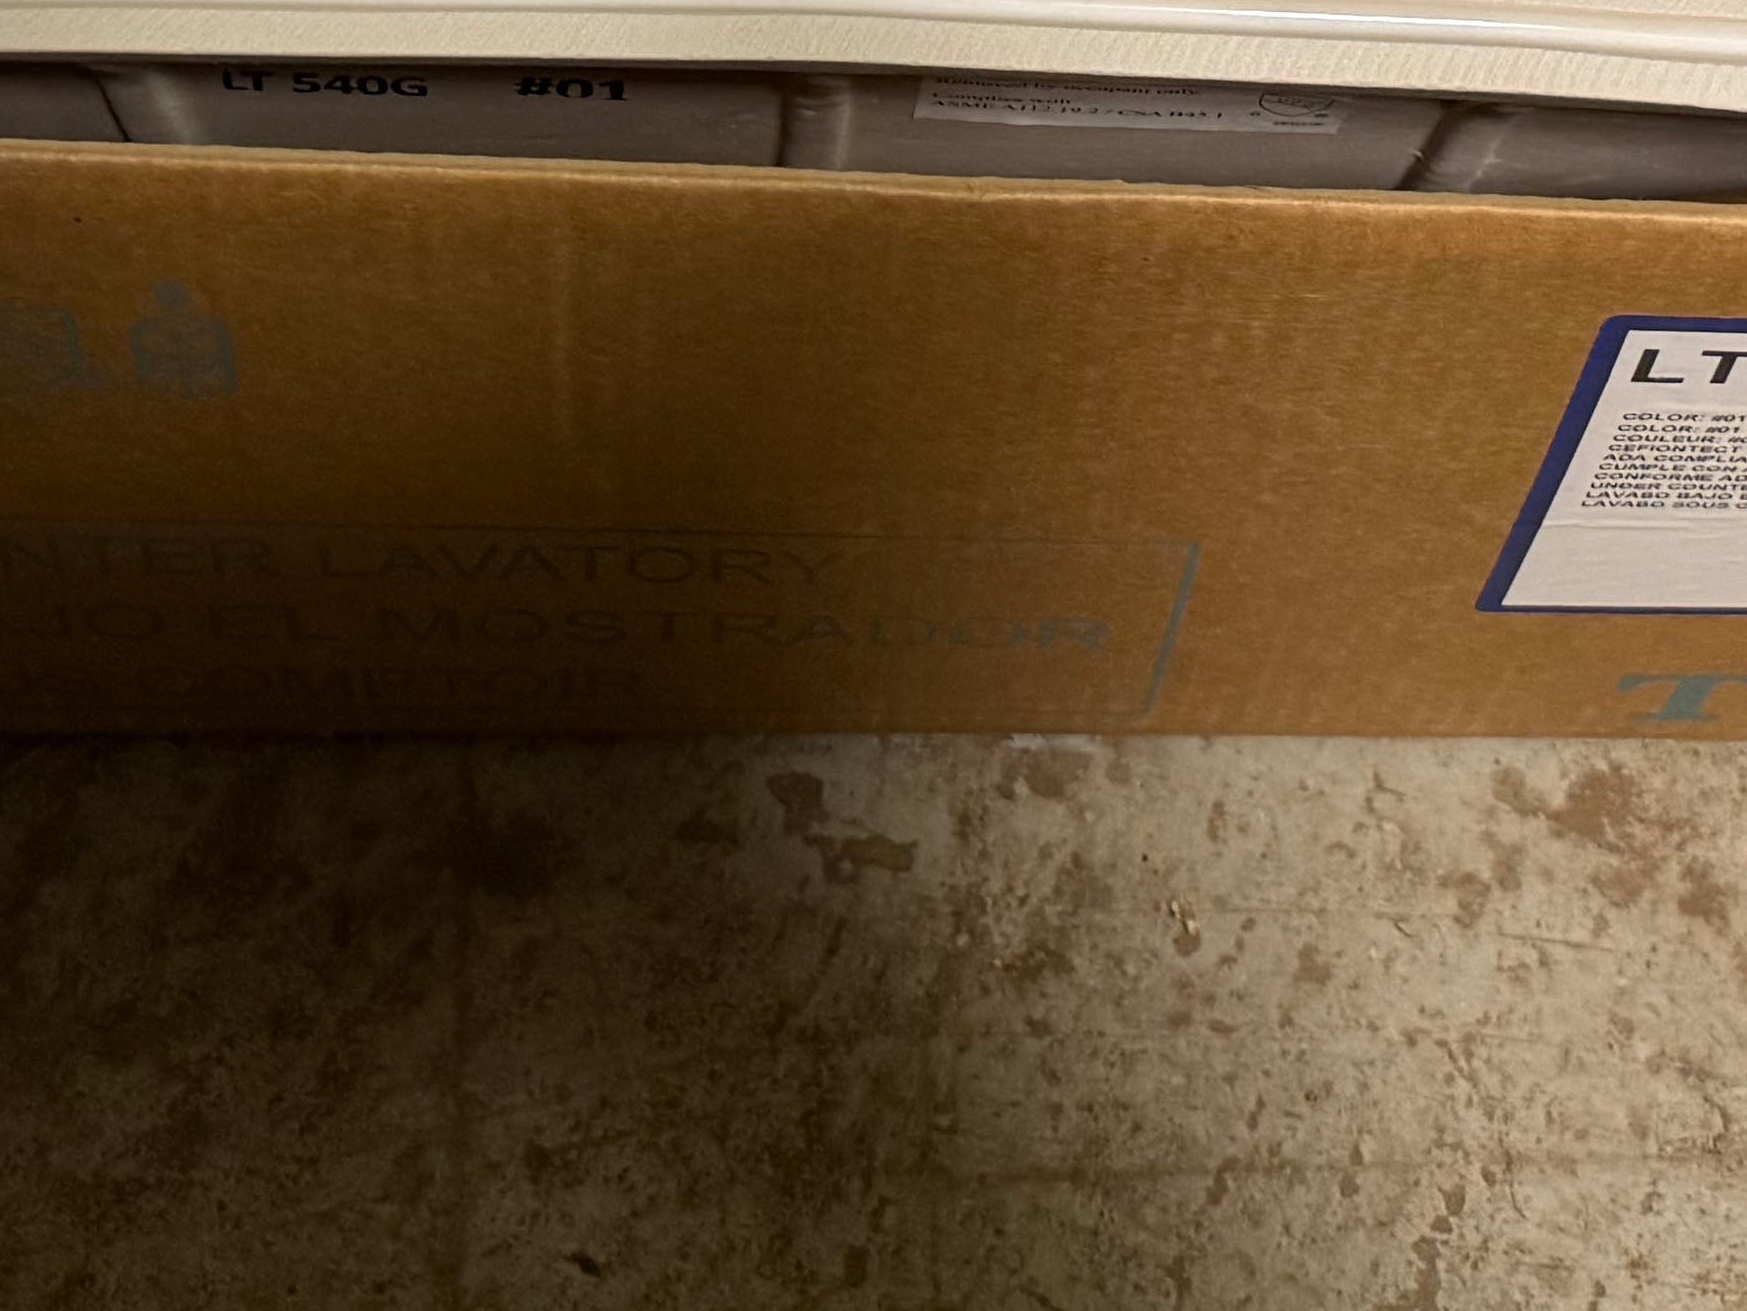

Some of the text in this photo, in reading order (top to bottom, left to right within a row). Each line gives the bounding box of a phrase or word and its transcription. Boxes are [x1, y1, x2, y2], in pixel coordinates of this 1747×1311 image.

[221, 68, 628, 101] LT 540G #01
[1622, 412, 1704, 422] COLOR:
[1712, 413, 1746, 422] #01
[1617, 424, 1698, 433] COLOR:
[1705, 426, 1740, 434] #01
[1612, 434, 1721, 444] COULEUR:
[1608, 444, 1742, 454] CEFIONTECT
[1603, 453, 1647, 462] ADA
[1598, 462, 1686, 472] CUMPLE
[1691, 465, 1738, 473] CON
[1593, 472, 1713, 481] CONFORME
[1590, 482, 1662, 491] UNDER
[1585, 491, 1671, 499] LAVABO
[1677, 492, 1734, 500] BAJO
[1580, 500, 1666, 508] LAVABO
[1672, 501, 1731, 509] SOUS
[315, 539, 848, 587] LAVATORY
[204, 601, 350, 644] EL
[373, 605, 1112, 651] MOSTRADOR
